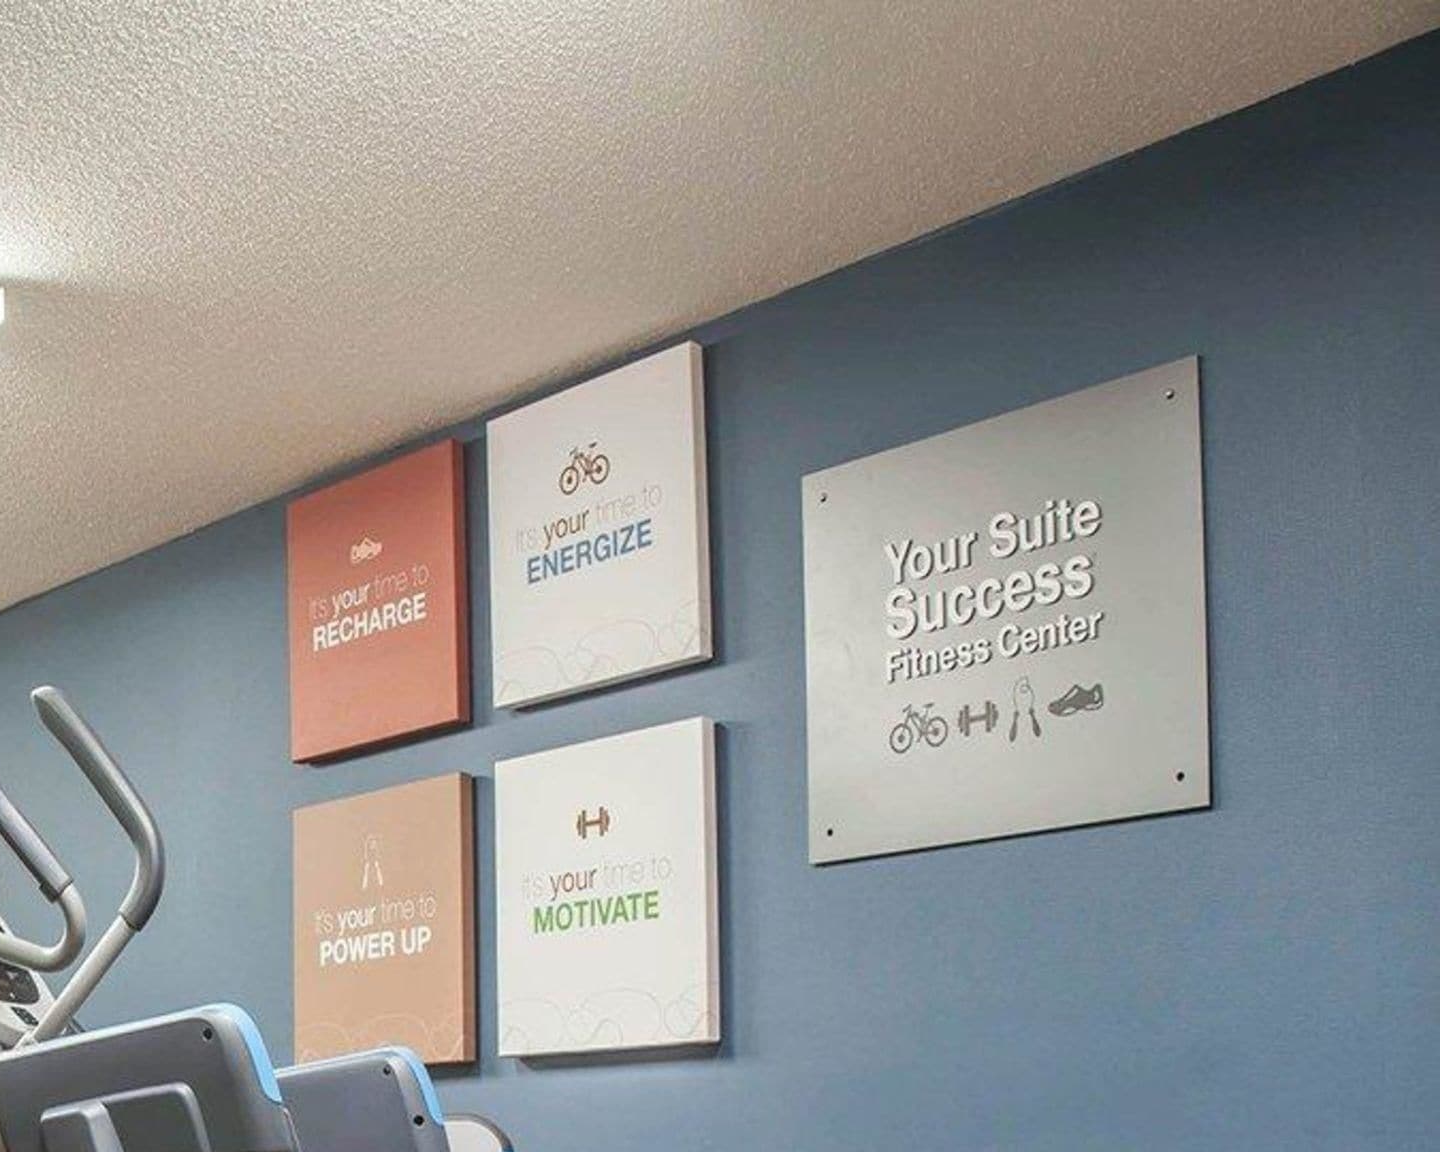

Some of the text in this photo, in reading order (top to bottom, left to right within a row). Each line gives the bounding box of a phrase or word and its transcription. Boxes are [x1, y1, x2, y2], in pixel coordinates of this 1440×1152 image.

[543, 509, 590, 550] your
[596, 493, 636, 521] time
[642, 483, 663, 510] to
[884, 497, 1103, 585] Your Suite
[527, 518, 652, 585] ENERGIZE
[332, 582, 370, 619] your
[374, 570, 408, 598] time
[411, 563, 430, 587] to
[884, 553, 1095, 640] Success
[312, 592, 427, 652] RECHARGE
[885, 609, 1106, 683] Fitness Center
[550, 867, 597, 902] your
[651, 856, 673, 881] to
[336, 905, 377, 937] your
[381, 896, 415, 923] time
[418, 894, 436, 918] to
[534, 890, 660, 935] MOTIVATE
[319, 925, 432, 967] POWER UP
